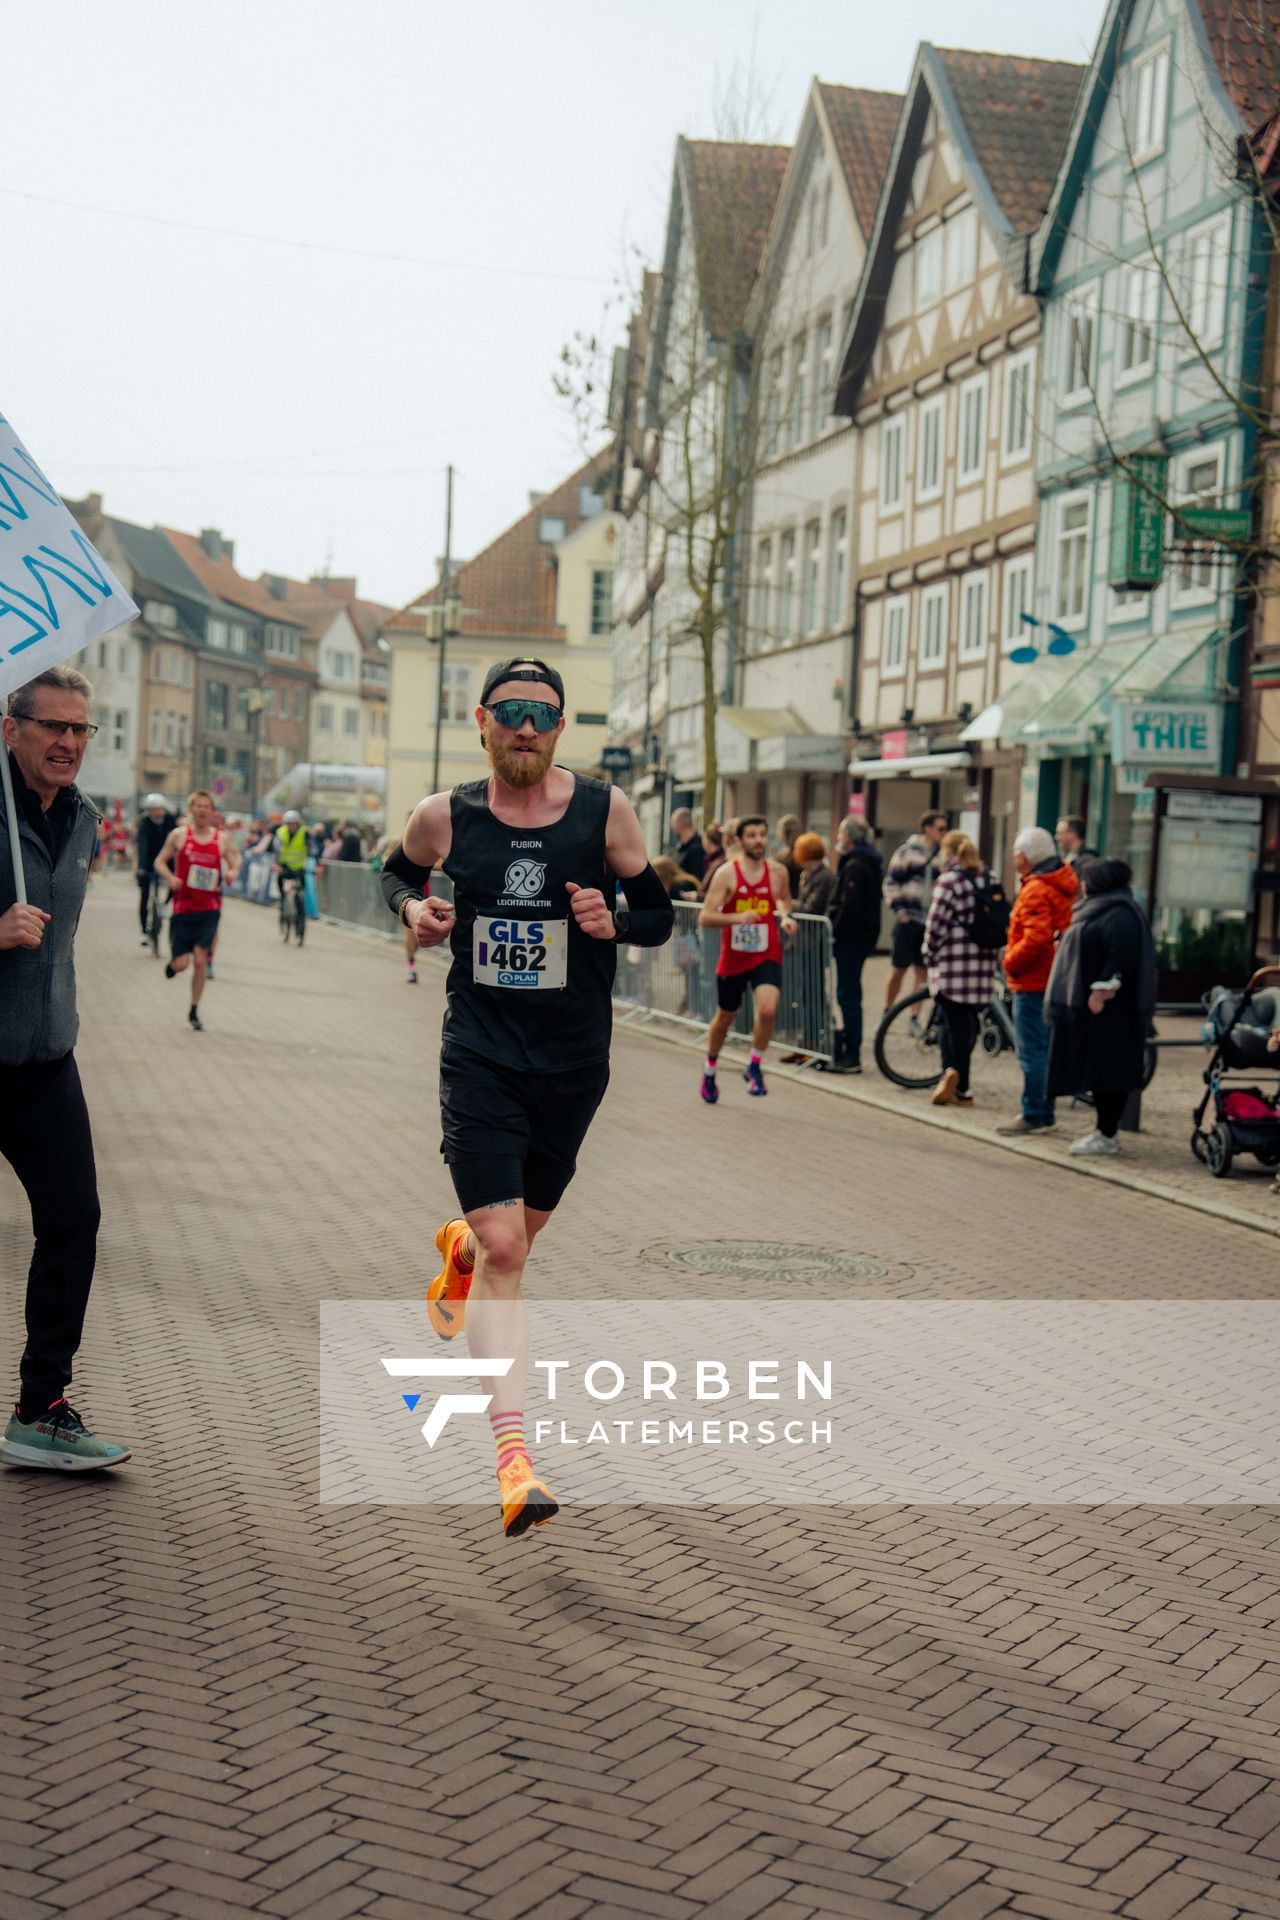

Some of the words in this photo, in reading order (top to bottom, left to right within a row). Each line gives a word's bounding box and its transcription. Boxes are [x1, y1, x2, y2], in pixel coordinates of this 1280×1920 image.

[1132, 723, 1208, 750] THIE
[511, 840, 542, 849] FUSION
[506, 862, 543, 894] 96
[496, 899, 552, 907] LEICHTATHLETIK
[490, 944, 547, 972] 462
[514, 974, 537, 982] PLAN
